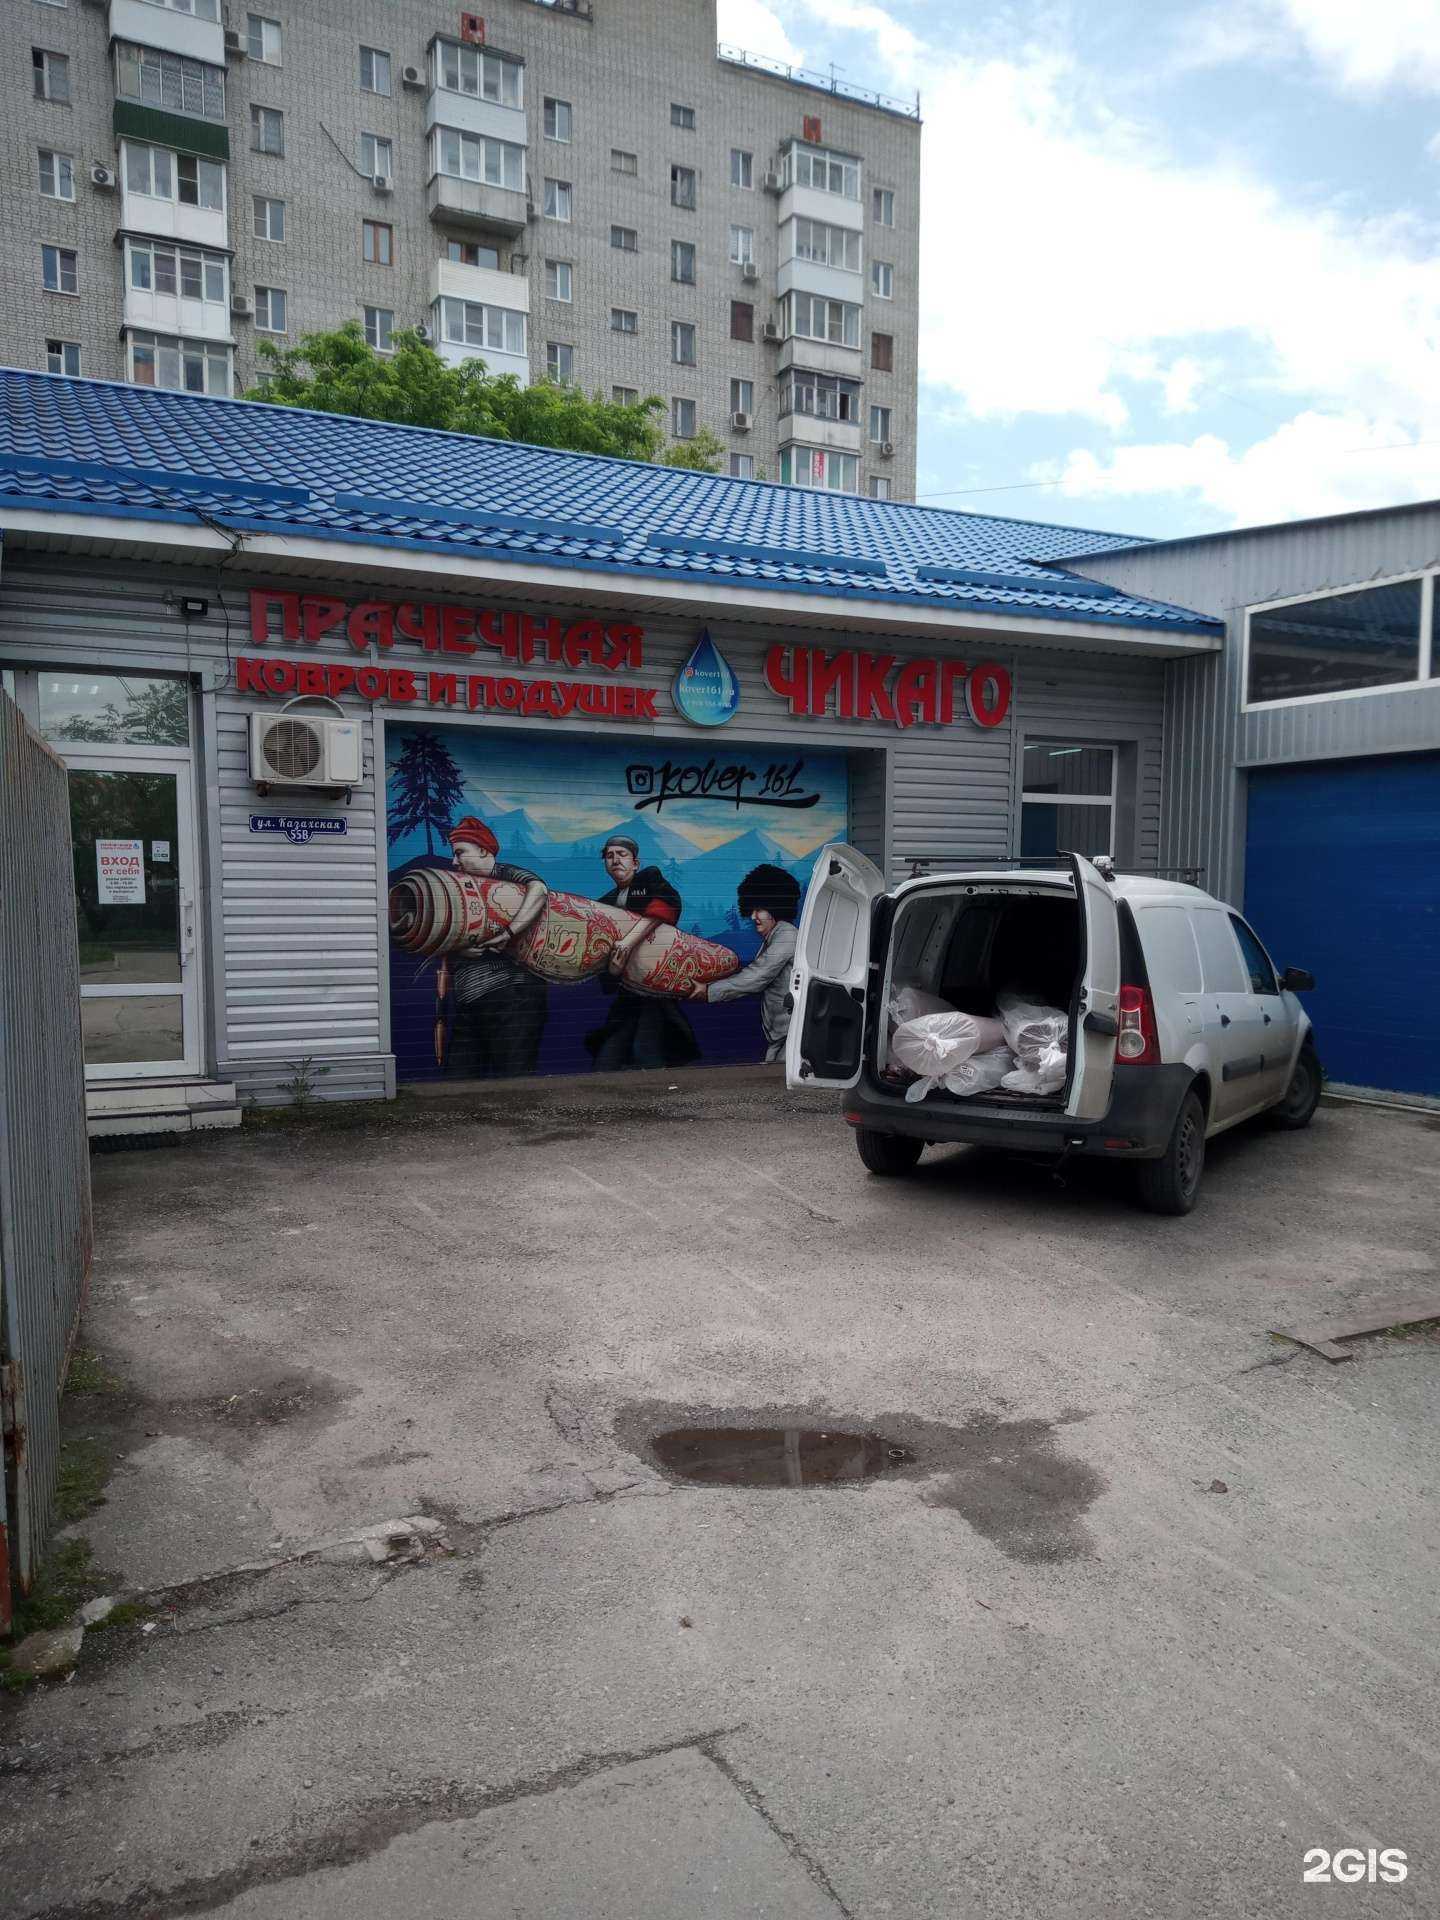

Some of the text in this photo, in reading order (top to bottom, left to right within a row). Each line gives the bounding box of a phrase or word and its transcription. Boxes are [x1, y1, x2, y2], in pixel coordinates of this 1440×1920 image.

[249, 588, 644, 670] ПРАЧЕЧНАЯ
[236, 656, 660, 719] КОВРОВ И ПОДУШЕК
[763, 644, 1011, 728] ЧИКАГО
[256, 817, 341, 831] ул. Казахская
[100, 856, 140, 868] ВХОД
[116, 867, 140, 876] себя
